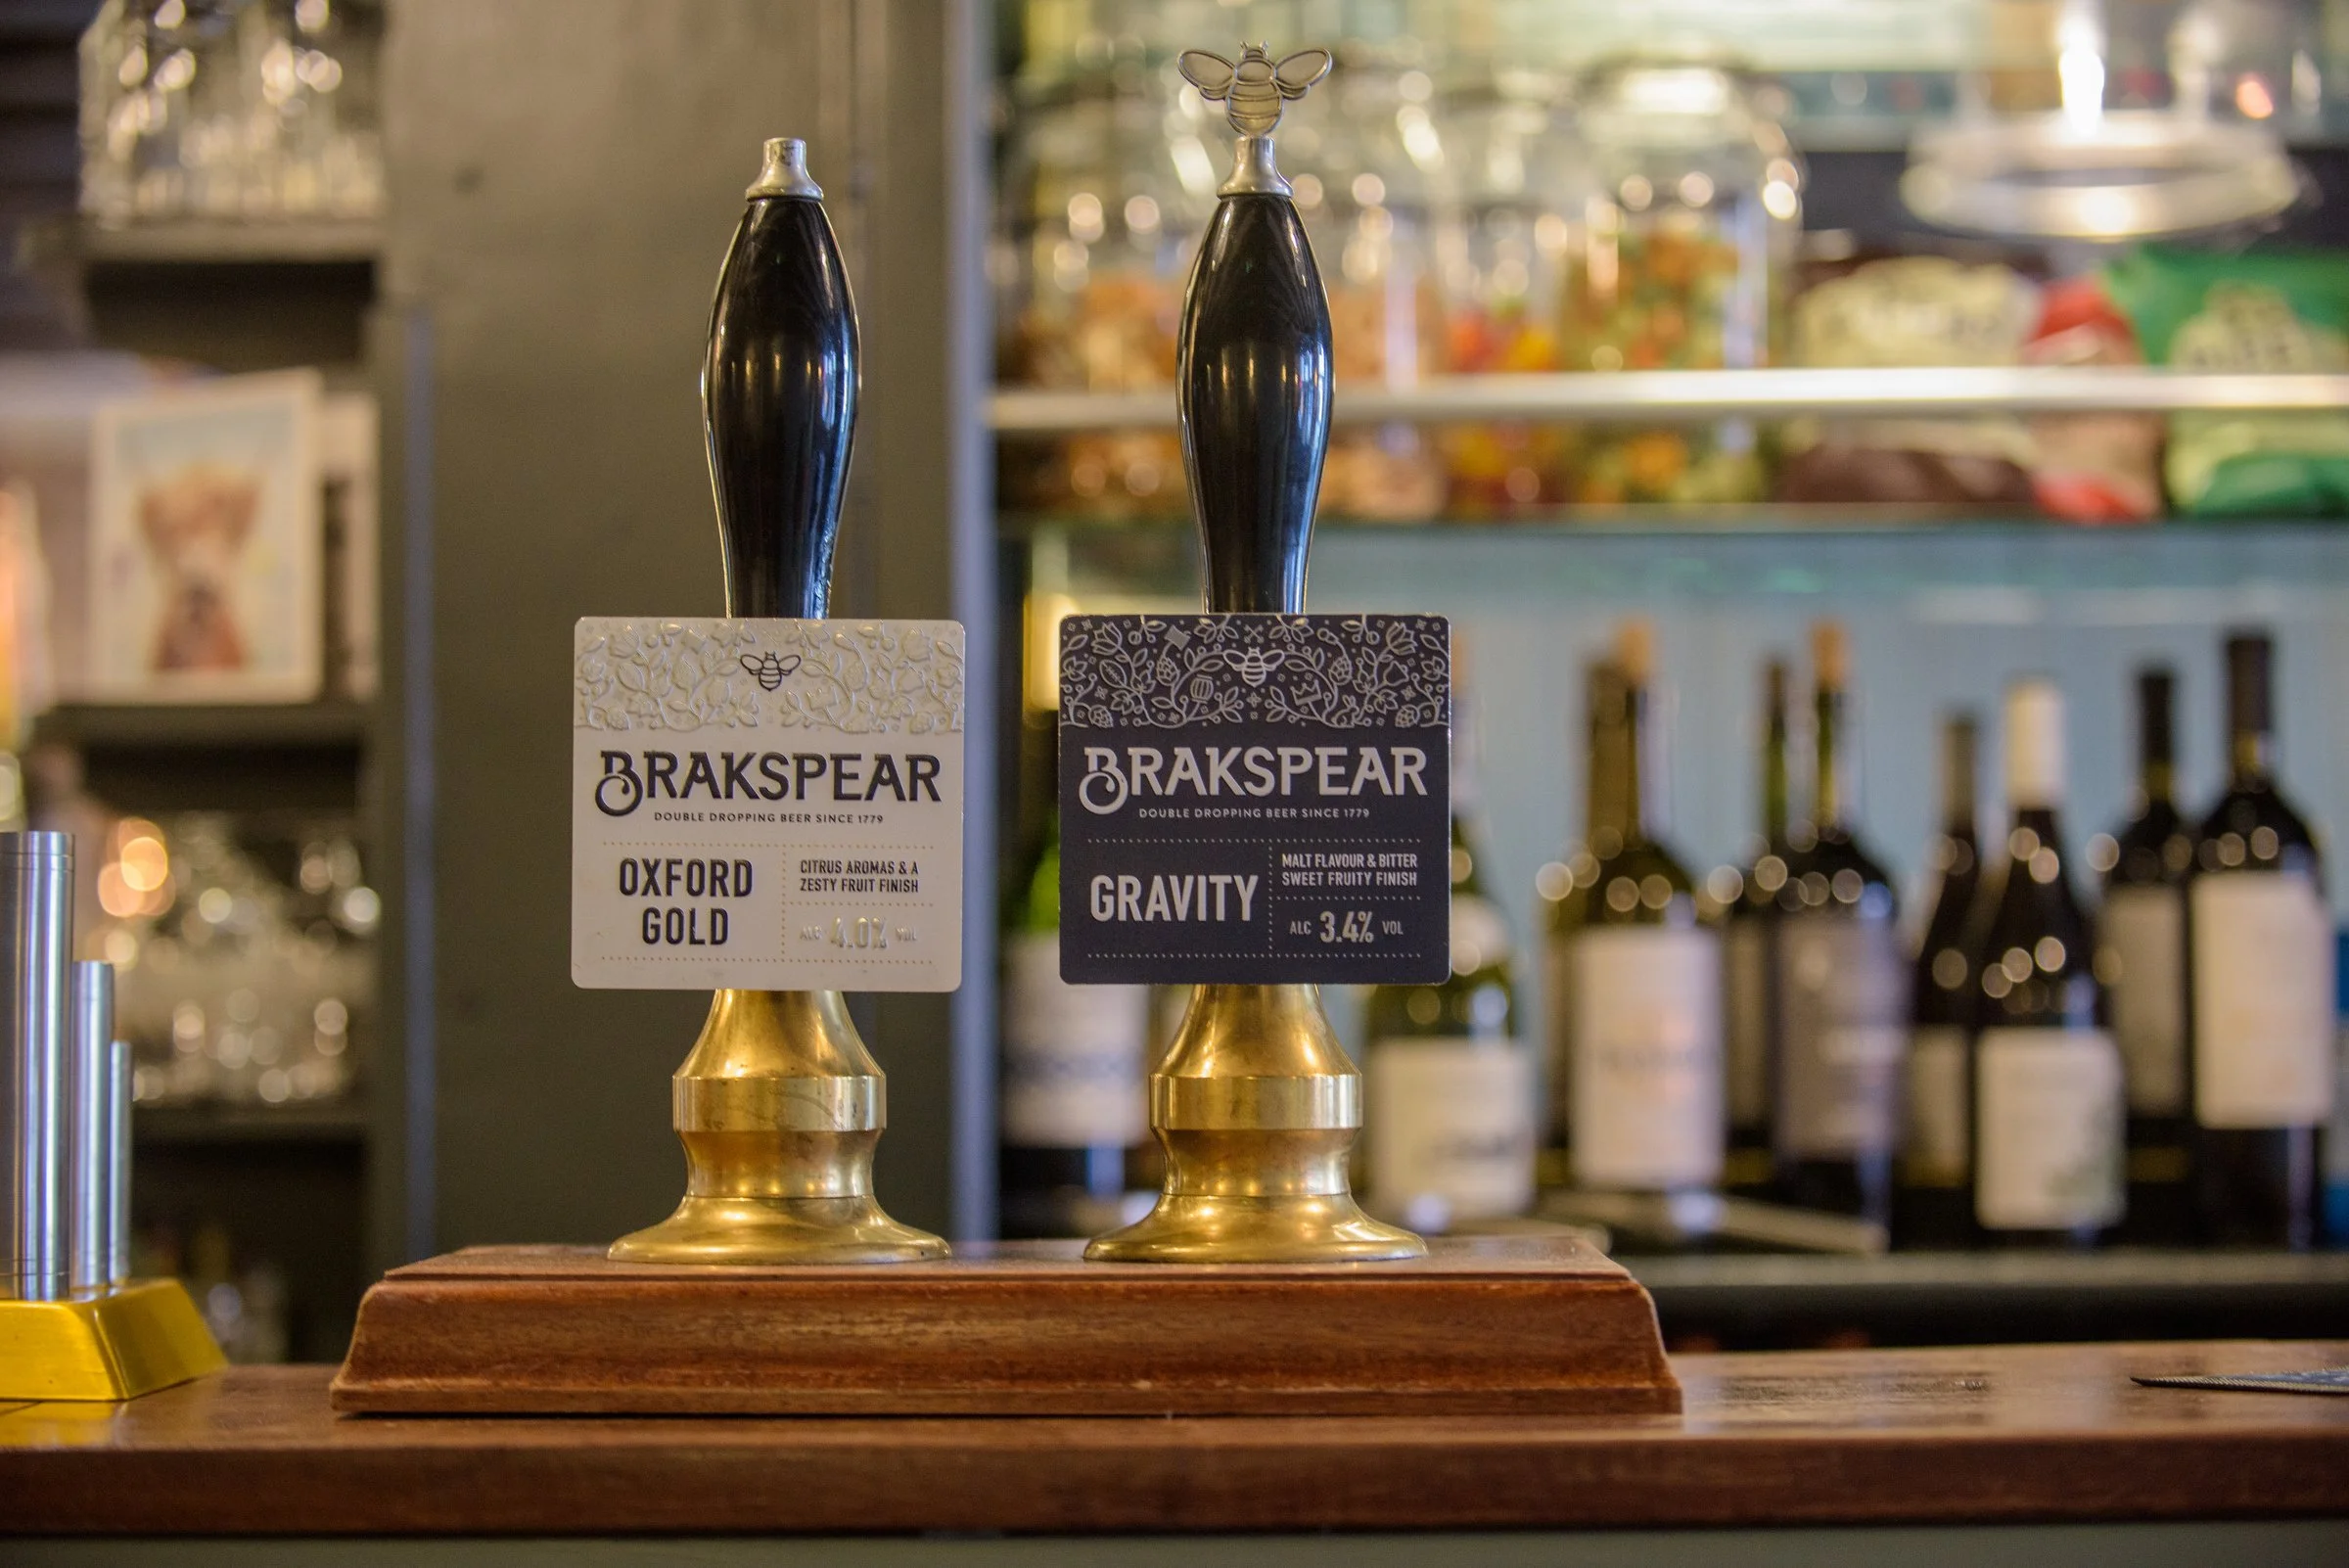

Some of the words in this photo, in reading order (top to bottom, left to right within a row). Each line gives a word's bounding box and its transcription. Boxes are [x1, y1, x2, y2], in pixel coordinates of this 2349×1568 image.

[594, 750, 942, 816] BRAKSPEAR
[1079, 746, 1428, 815] BRAKSPEAR
[654, 812, 705, 822] DOUBLE
[710, 812, 776, 823] DROPPING
[781, 813, 811, 823] BEER
[815, 813, 853, 824] SINCE
[857, 815, 884, 824] 1779
[1139, 808, 1190, 818] DOUBLE
[1194, 808, 1262, 818] DROPPING
[1267, 808, 1298, 818] BEER
[1302, 808, 1340, 818] SINCE
[1344, 808, 1369, 818] 1779
[800, 859, 842, 874] CITRUS
[846, 860, 895, 874] AROMAS
[898, 861, 907, 874] &
[909, 861, 919, 874] A
[1282, 853, 1312, 868] MALT
[1314, 853, 1364, 868] FLAVOUR
[1367, 853, 1376, 868] &
[1378, 853, 1417, 868] BITTER
[619, 857, 754, 898] OXFORD
[800, 878, 837, 892] ZESTY
[841, 878, 875, 893] FRUIT
[879, 879, 919, 893] FINISH
[1282, 872, 1323, 887] SWEET
[1328, 872, 1372, 887] FRUITY
[1376, 872, 1417, 887] FINISH
[1090, 874, 1259, 921] GRAVITY
[641, 907, 729, 945] GOLD
[830, 916, 888, 948] 4.0%
[1290, 920, 1312, 935] ALC
[1319, 911, 1374, 944] 3.4%
[1382, 921, 1404, 936] VOL
